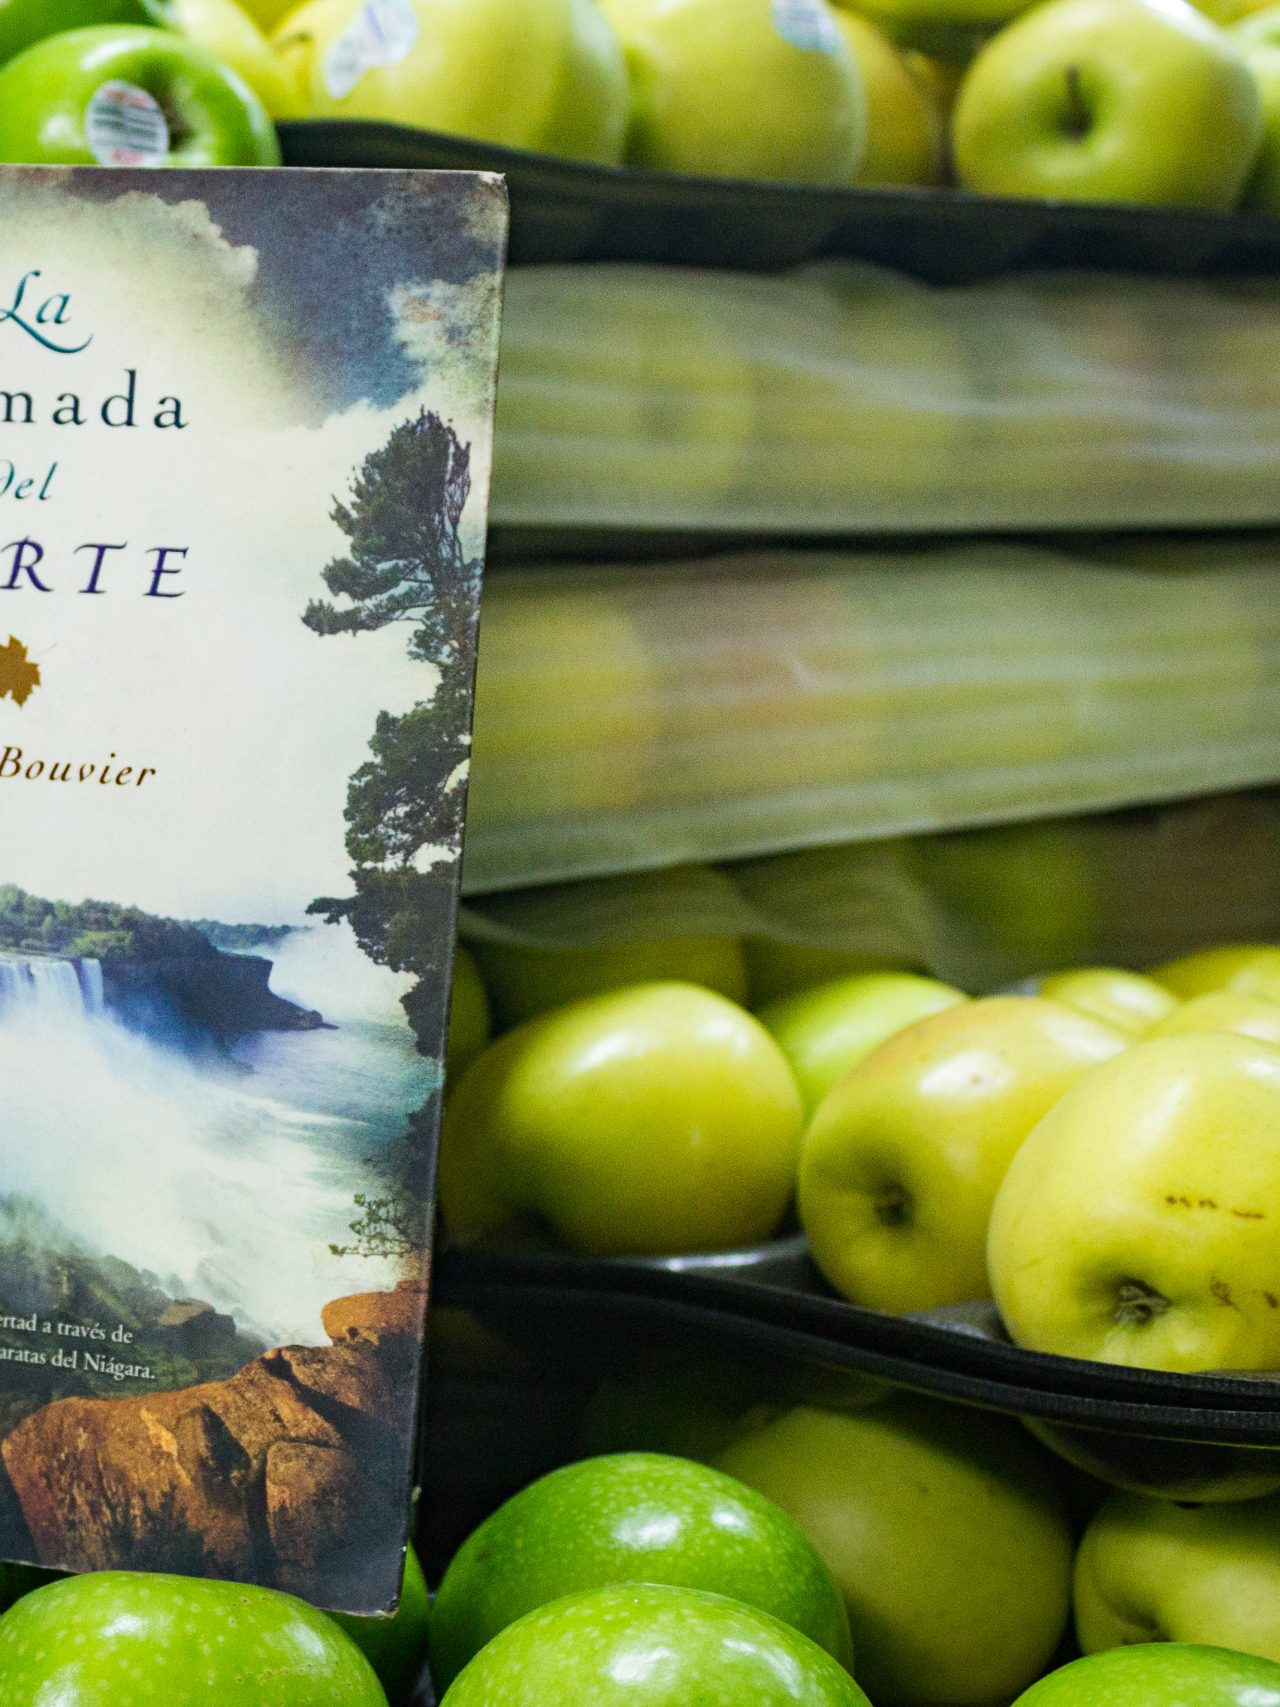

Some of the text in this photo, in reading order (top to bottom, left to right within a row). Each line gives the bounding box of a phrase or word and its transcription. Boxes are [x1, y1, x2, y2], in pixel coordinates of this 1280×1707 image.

[42, 1322, 51, 1333] a
[57, 1322, 106, 1340] través
[111, 1324, 133, 1343] de
[51, 1349, 77, 1369] del
[84, 1352, 155, 1381] Niágara.
